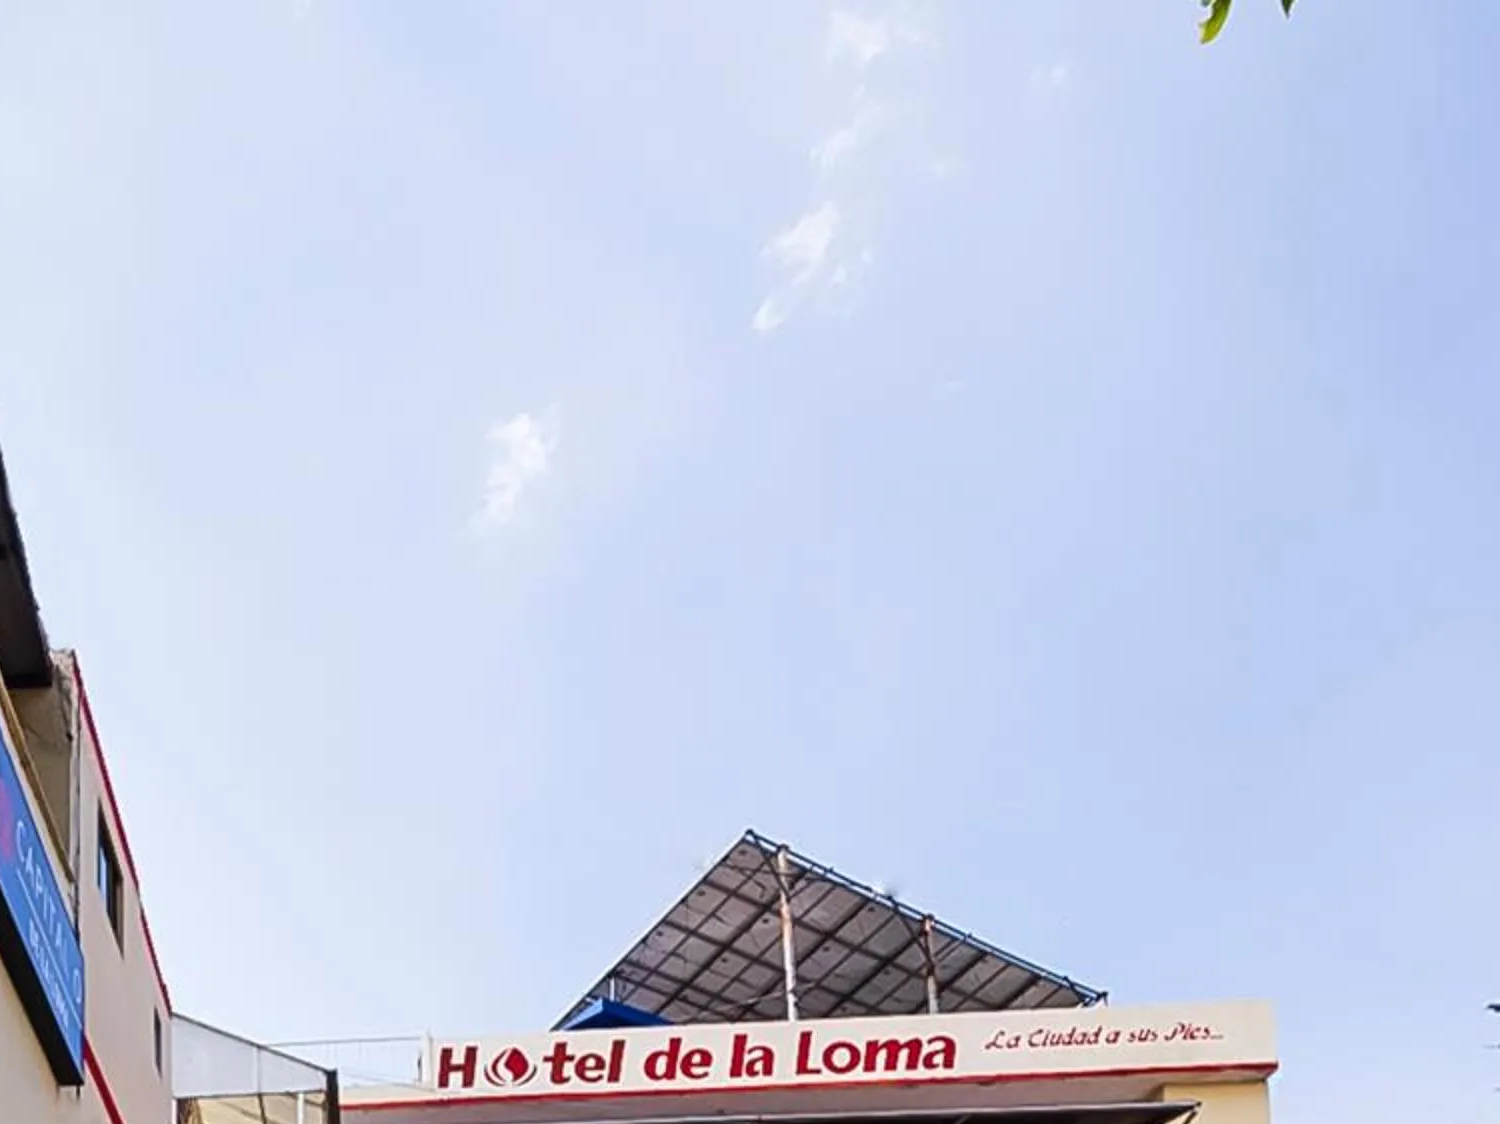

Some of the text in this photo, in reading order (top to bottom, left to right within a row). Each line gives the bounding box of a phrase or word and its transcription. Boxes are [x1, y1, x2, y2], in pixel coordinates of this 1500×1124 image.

[643, 1037, 713, 1081] de
[729, 1034, 775, 1078] la
[797, 1030, 957, 1076] Loma
[984, 1030, 1019, 1050] La
[1027, 1025, 1102, 1048] Ciudad
[1105, 1028, 1121, 1045] a
[1127, 1024, 1159, 1043] sus
